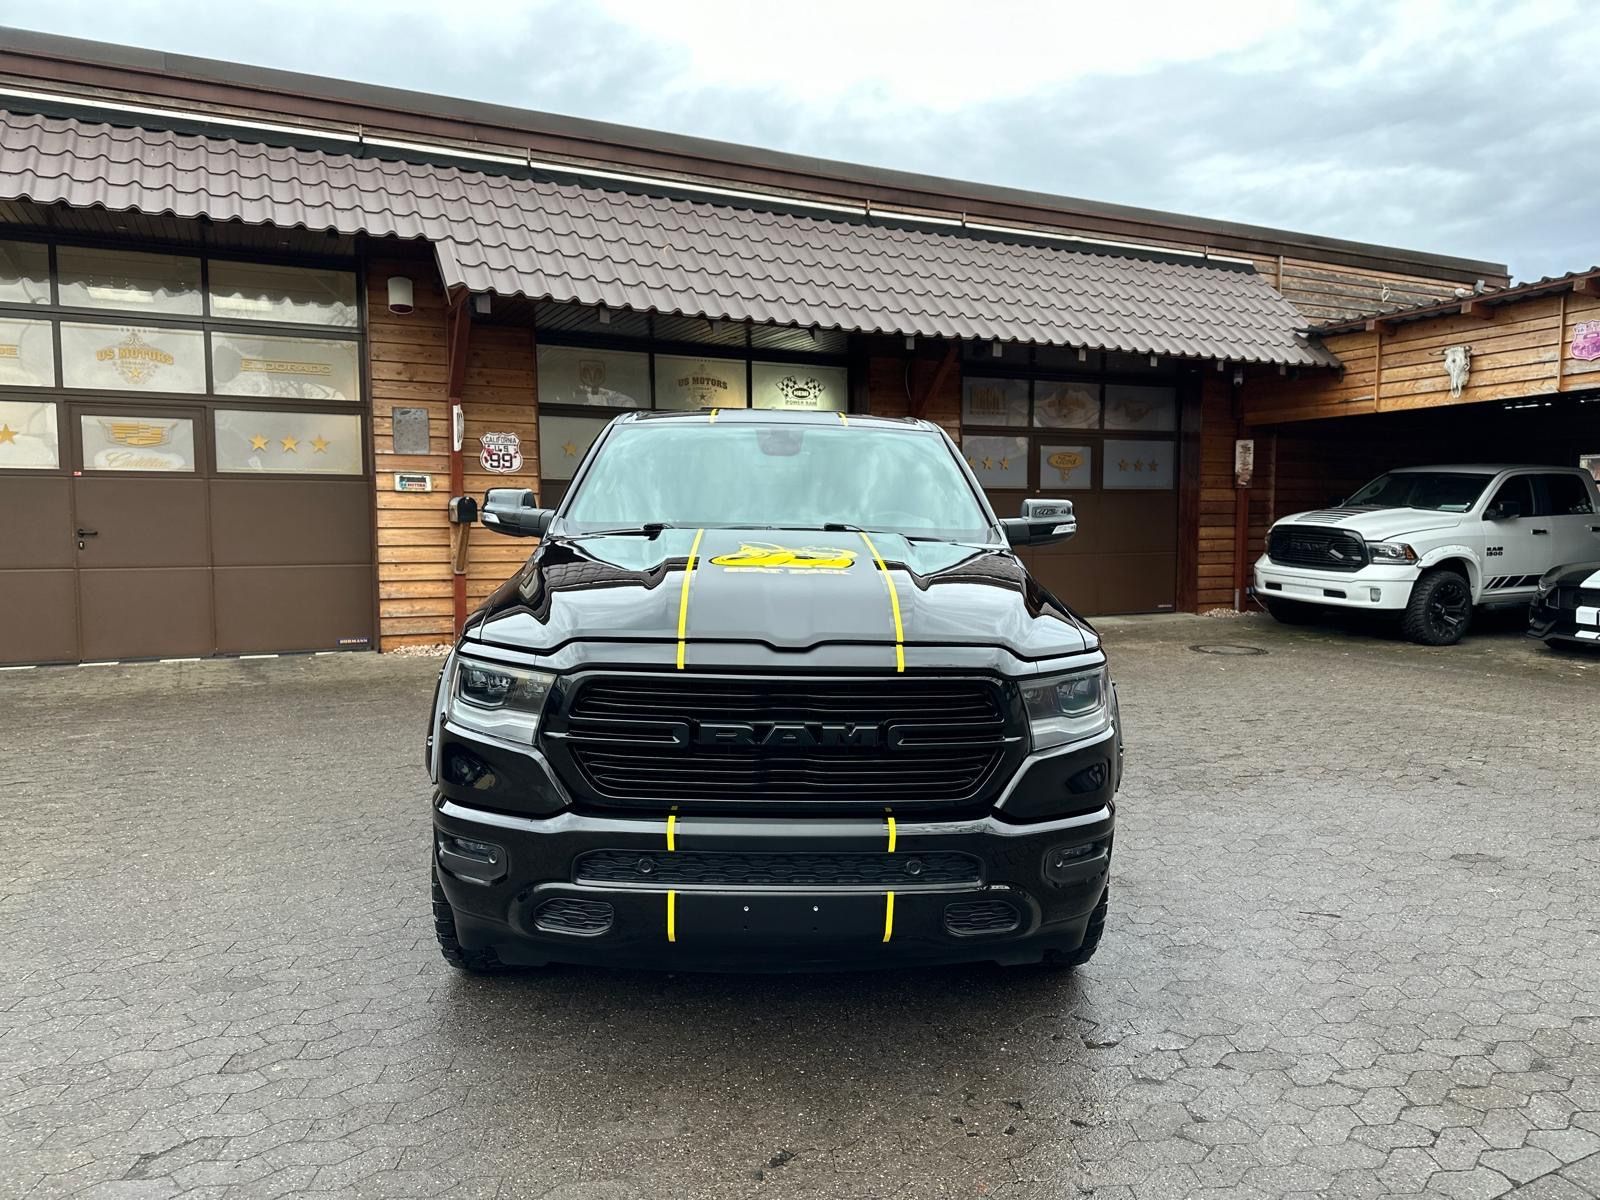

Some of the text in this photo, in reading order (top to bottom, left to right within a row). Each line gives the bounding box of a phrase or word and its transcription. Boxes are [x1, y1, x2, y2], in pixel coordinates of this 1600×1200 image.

[692, 376, 728, 390] MOTORS
[484, 435, 517, 444] CALIFORNIA
[489, 452, 513, 469] 99
[698, 720, 879, 746] RAM
